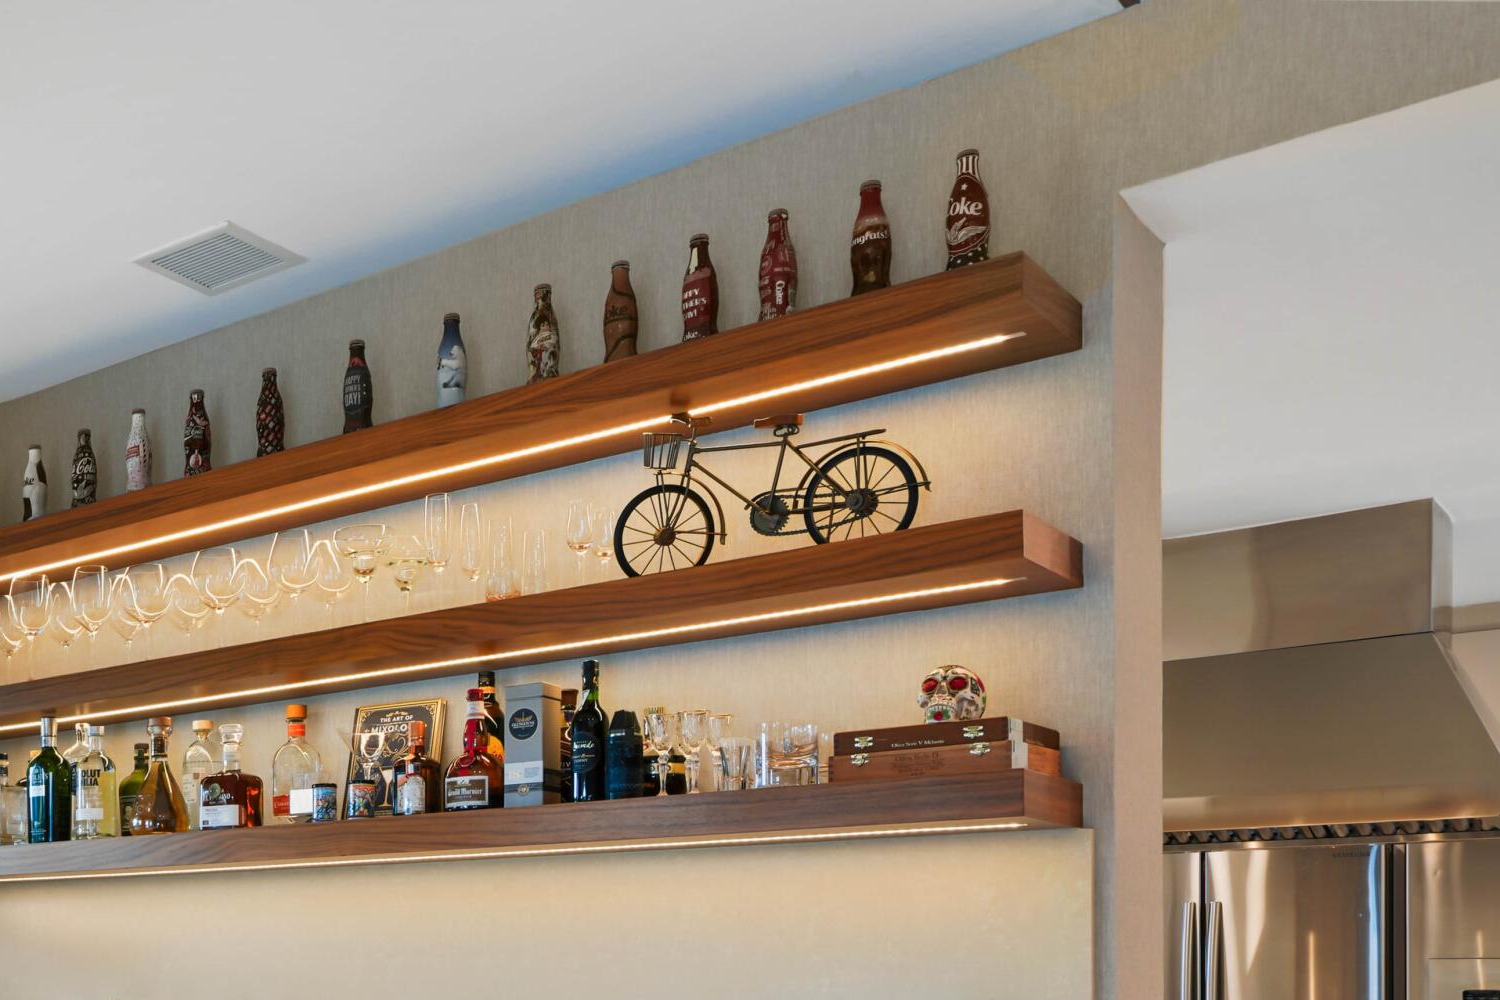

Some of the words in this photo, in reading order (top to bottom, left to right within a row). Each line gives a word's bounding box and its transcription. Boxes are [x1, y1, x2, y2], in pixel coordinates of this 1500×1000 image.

[947, 196, 983, 216] oke
[852, 230, 888, 246] ongrats!
[371, 723, 408, 734] MIXOLO
